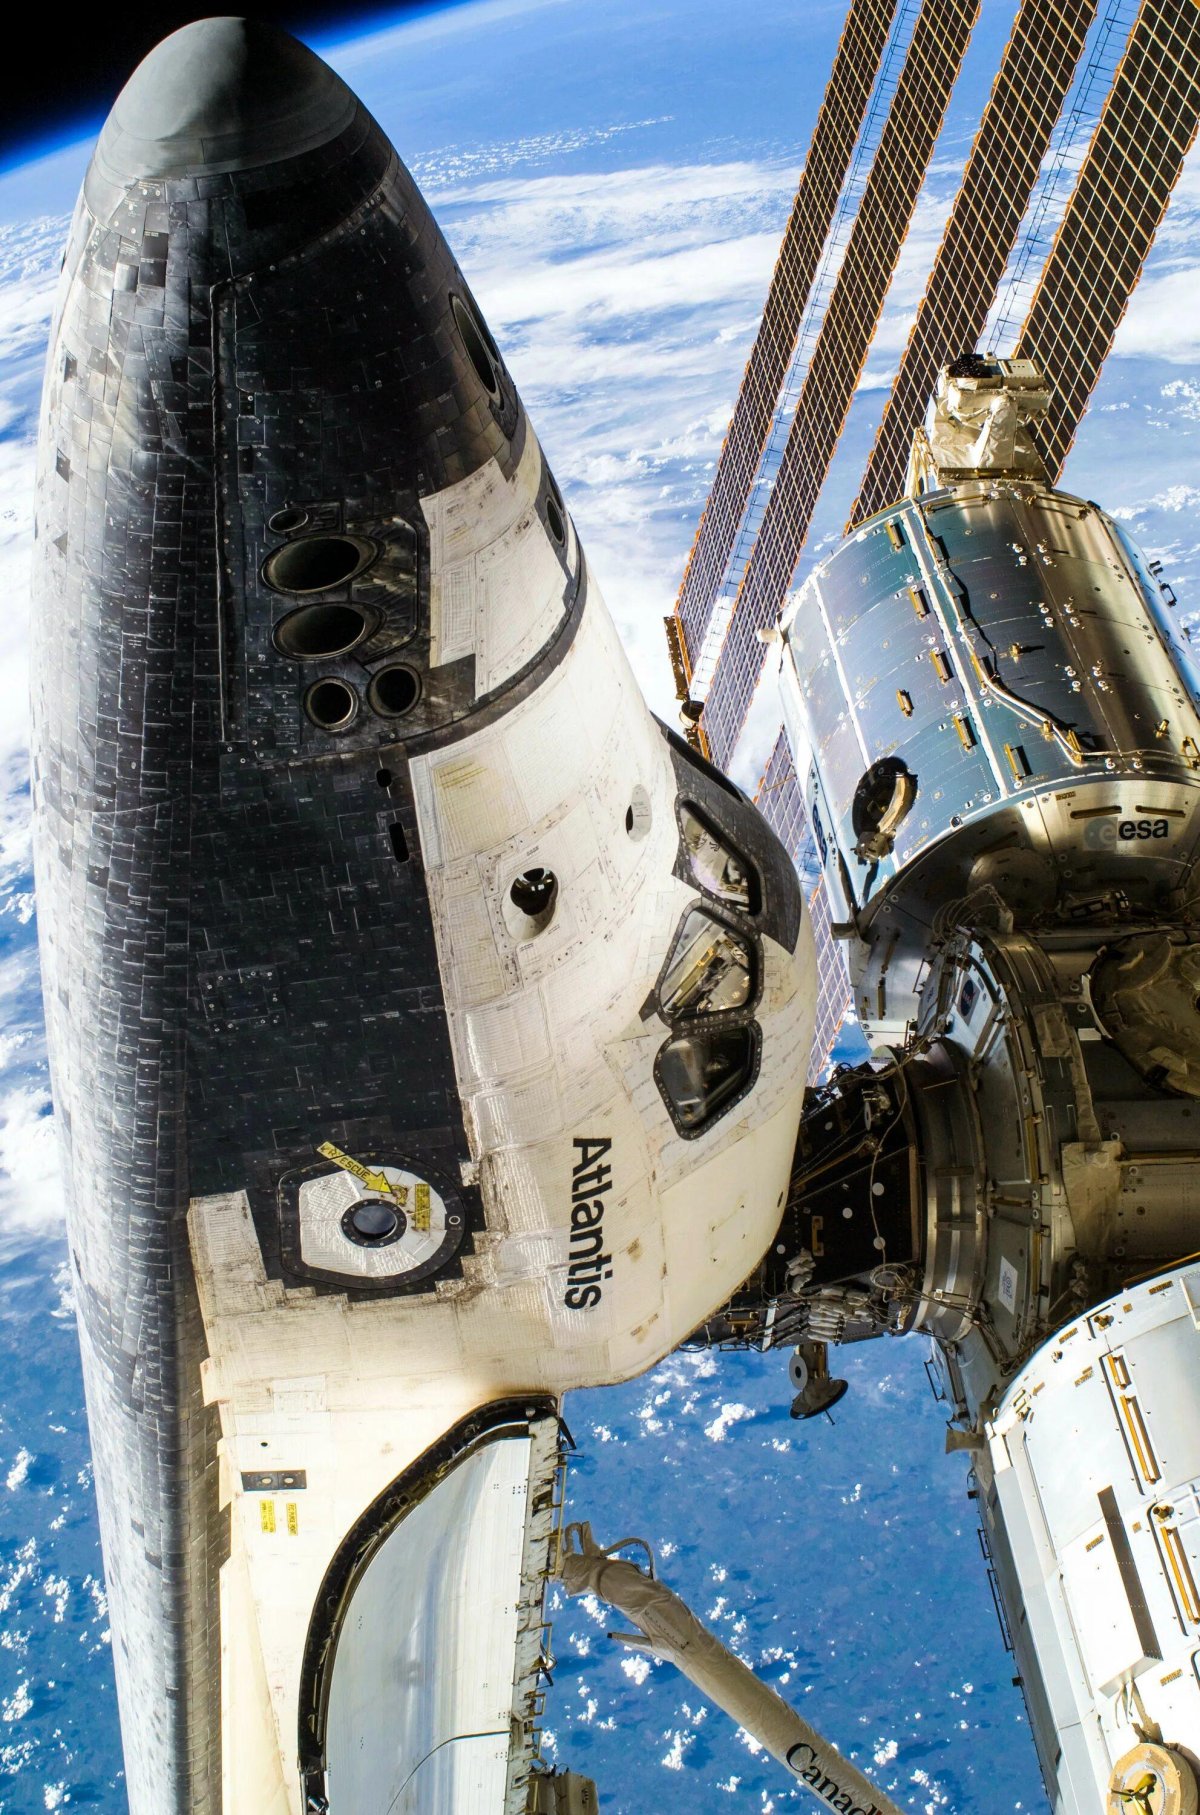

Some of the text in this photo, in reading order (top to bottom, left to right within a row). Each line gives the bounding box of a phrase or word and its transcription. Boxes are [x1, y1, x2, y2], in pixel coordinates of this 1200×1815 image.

[1118, 819, 1169, 841] esa
[328, 1147, 371, 1180] RESCUE
[564, 1137, 614, 1311] Atlantis
